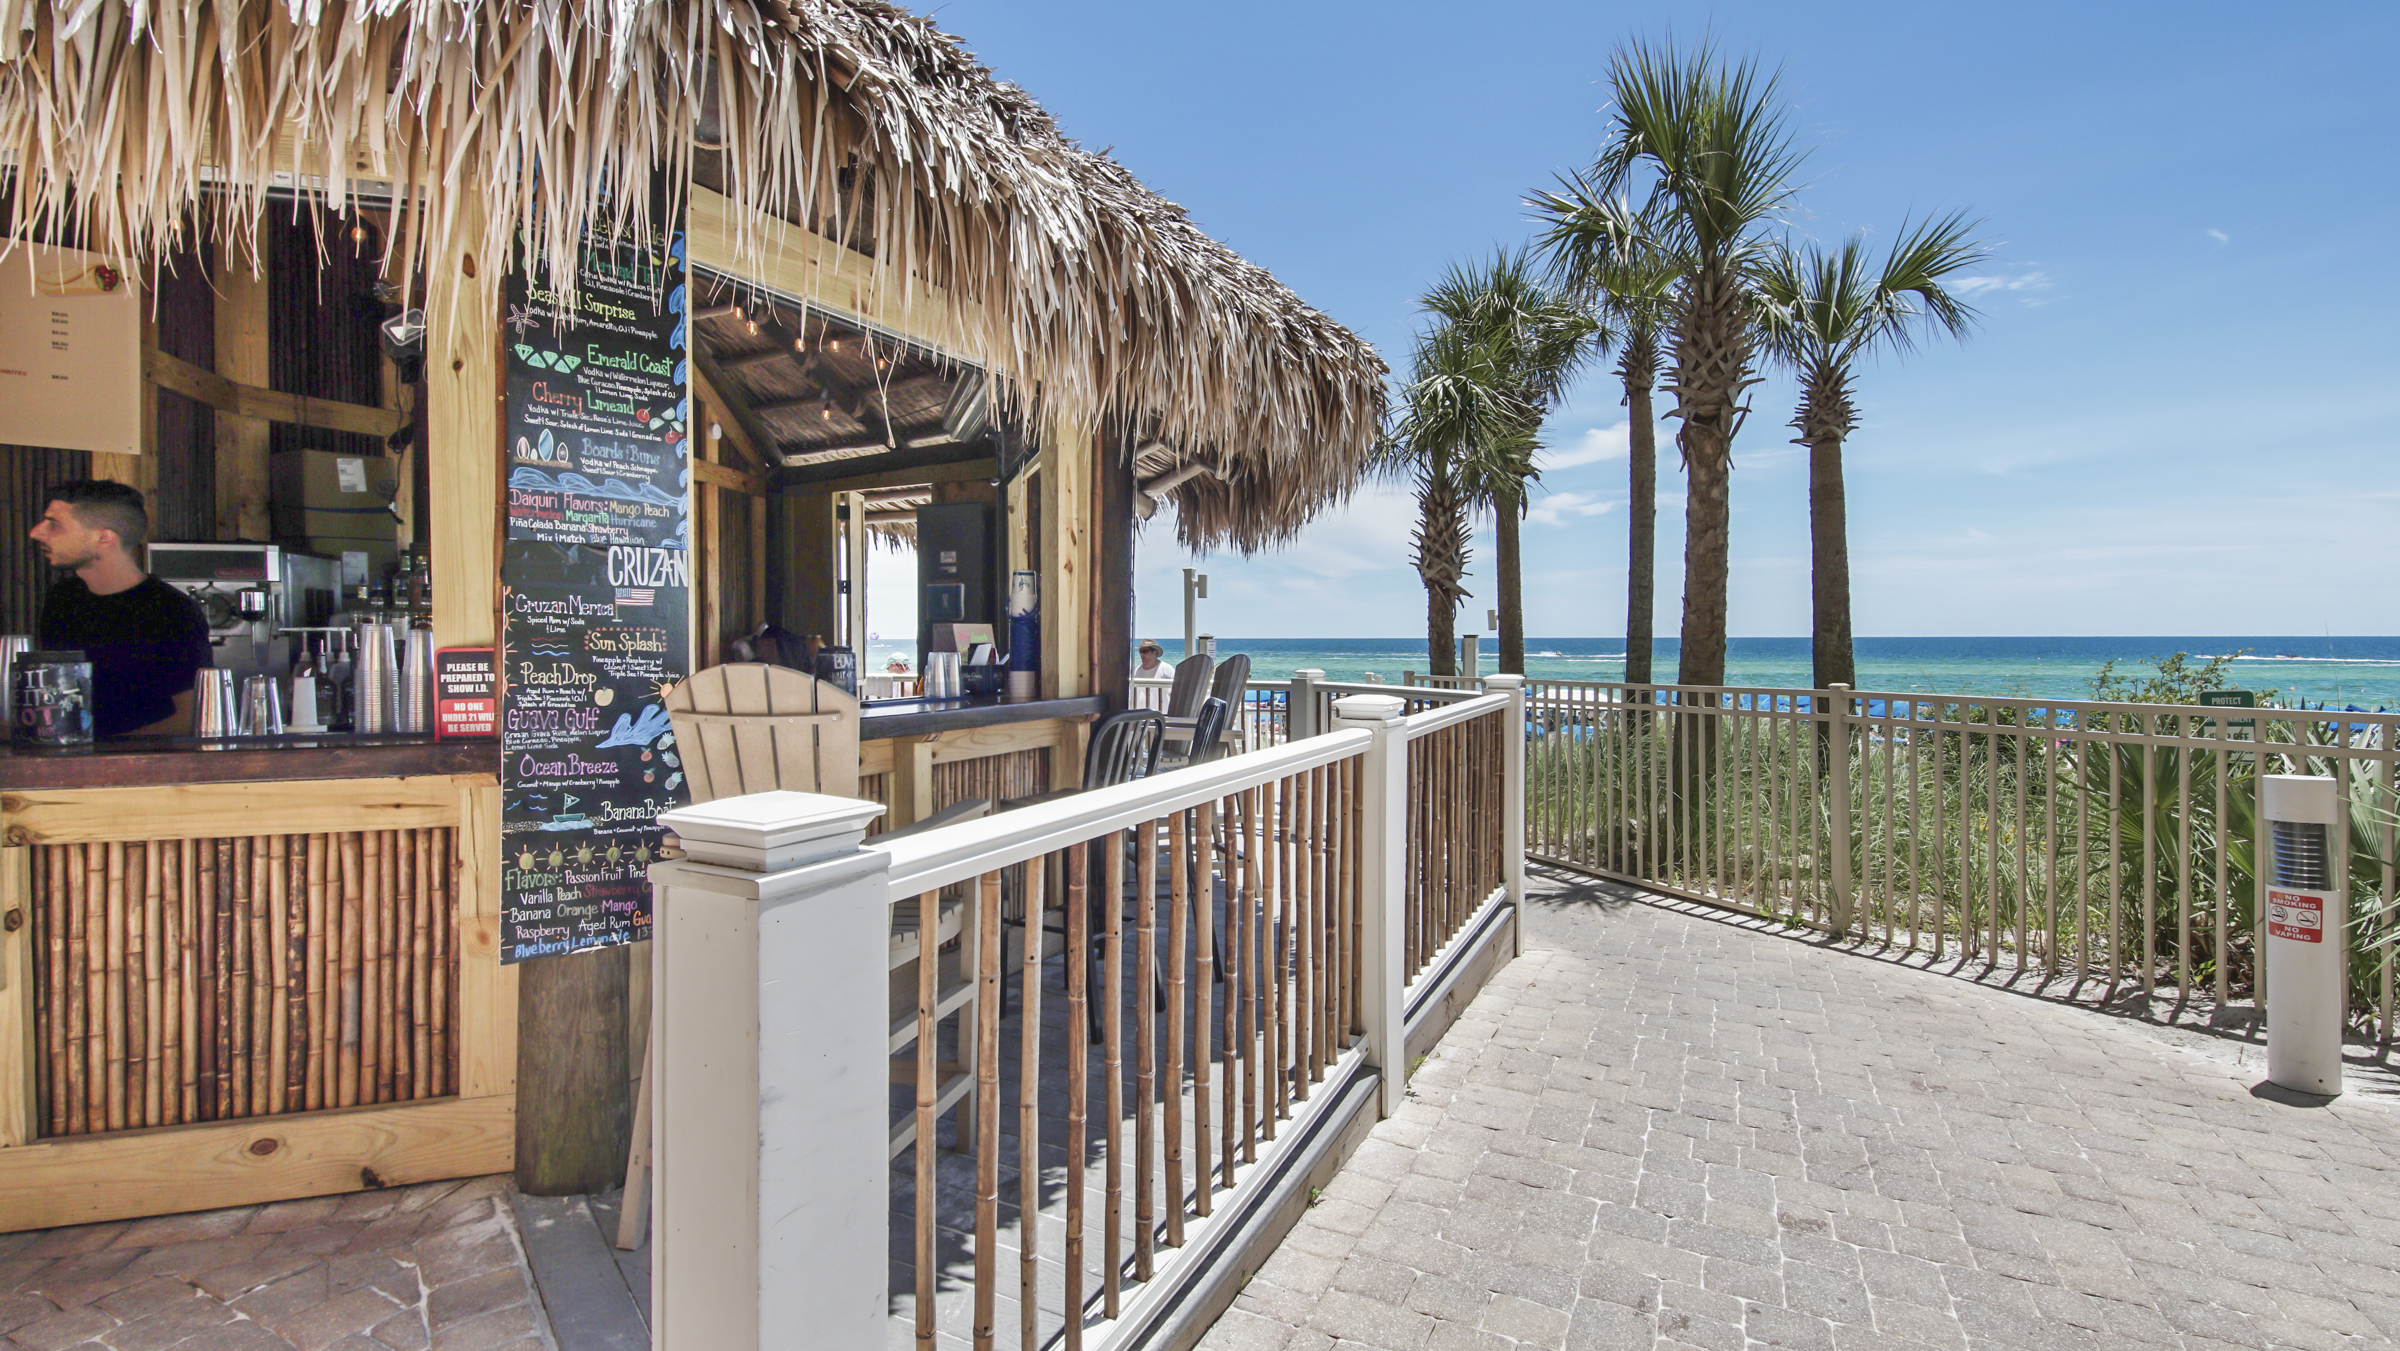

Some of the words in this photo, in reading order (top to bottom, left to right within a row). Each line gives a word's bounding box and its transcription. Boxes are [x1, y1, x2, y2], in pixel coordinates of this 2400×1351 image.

[525, 278, 581, 310] Seasell
[584, 292, 636, 321] Surprise
[524, 303, 545, 317] Vodka
[630, 326, 658, 340] Pineapple
[587, 344, 637, 371] Emerald
[640, 353, 674, 377] Coast
[583, 366, 604, 378] Vodka
[532, 381, 582, 416] Cherry
[598, 387, 618, 397] Lemon
[634, 392, 648, 401] Soda
[527, 403, 549, 414] Vodka
[612, 417, 627, 426] Lime
[560, 420, 578, 430] Splash
[581, 437, 623, 459] Boards
[630, 444, 660, 465] Buns
[580, 457, 603, 468] Vodka
[612, 460, 629, 470] Peach
[619, 470, 650, 484] Cranberry
[509, 488, 558, 512] Daiquiri
[563, 492, 608, 512] Flavors:
[609, 500, 641, 519] Mango
[643, 502, 670, 518] Peach
[509, 505, 564, 521] Watermelon
[565, 509, 609, 527] Margarita
[610, 512, 657, 528] Hurricane
[509, 516, 528, 528] Piña
[528, 518, 553, 530] Colada
[553, 519, 586, 533] Banana
[536, 533, 553, 542] Mix
[558, 533, 586, 544] Match
[590, 533, 607, 544] Blue
[607, 545, 688, 588] CRUZAN
[515, 593, 568, 614] Cruzan
[569, 594, 614, 616] Merica
[527, 615, 547, 626] Spiced
[548, 616, 561, 624] Rum
[570, 617, 585, 625] Soda
[550, 625, 566, 633] Lime
[589, 632, 617, 651] Sun
[618, 632, 662, 657] Splash
[446, 663, 476, 672] PLEASE
[477, 662, 488, 671] BE
[592, 655, 621, 667] Pineapple
[626, 656, 654, 667] Raspberry
[440, 673, 482, 683] PREPARED
[484, 673, 495, 682] TO
[520, 661, 562, 686] Peach
[561, 662, 597, 692] Drop
[608, 670, 626, 680] Triple
[640, 671, 664, 681] Pineapple
[665, 670, 680, 678] Juice
[447, 684, 474, 693] SHOW
[475, 684, 489, 693] I.D.
[453, 702, 466, 711] NO
[467, 702, 484, 711] ONE
[2211, 697, 2242, 705] PROTECT
[442, 713, 467, 722] UNDER
[468, 713, 477, 721] 21
[507, 708, 559, 731] Guava
[564, 707, 600, 731] Gulf
[447, 723, 459, 732] BE
[460, 723, 491, 732] SERVED
[520, 753, 567, 777] Ocean
[567, 753, 619, 776] Breeze
[517, 779, 538, 788] Coconut
[542, 780, 561, 791] Mango
[569, 779, 596, 790] Cranberry
[600, 800, 645, 822] Banana
[643, 796, 677, 820] Boat
[616, 825, 636, 834] Coconut
[505, 867, 562, 891] Flavors:
[564, 867, 600, 885] Passion
[600, 866, 624, 882] Fruit
[520, 888, 553, 905] Vanilla
[556, 885, 582, 902] Peach
[582, 883, 640, 899] Strawberry
[2284, 894, 2300, 902] NO
[2272, 897, 2317, 909] SMOKING
[509, 907, 551, 923] Banana
[556, 903, 598, 921] Orange
[602, 899, 637, 916] Mango
[515, 923, 570, 942] Raspberry
[578, 916, 606, 936] Aged
[609, 915, 631, 929] Rum
[2275, 929, 2311, 940] VAPING
[2284, 925, 2299, 933] NO
[514, 937, 570, 959] Blueberry
[571, 928, 631, 948] Lemonade
